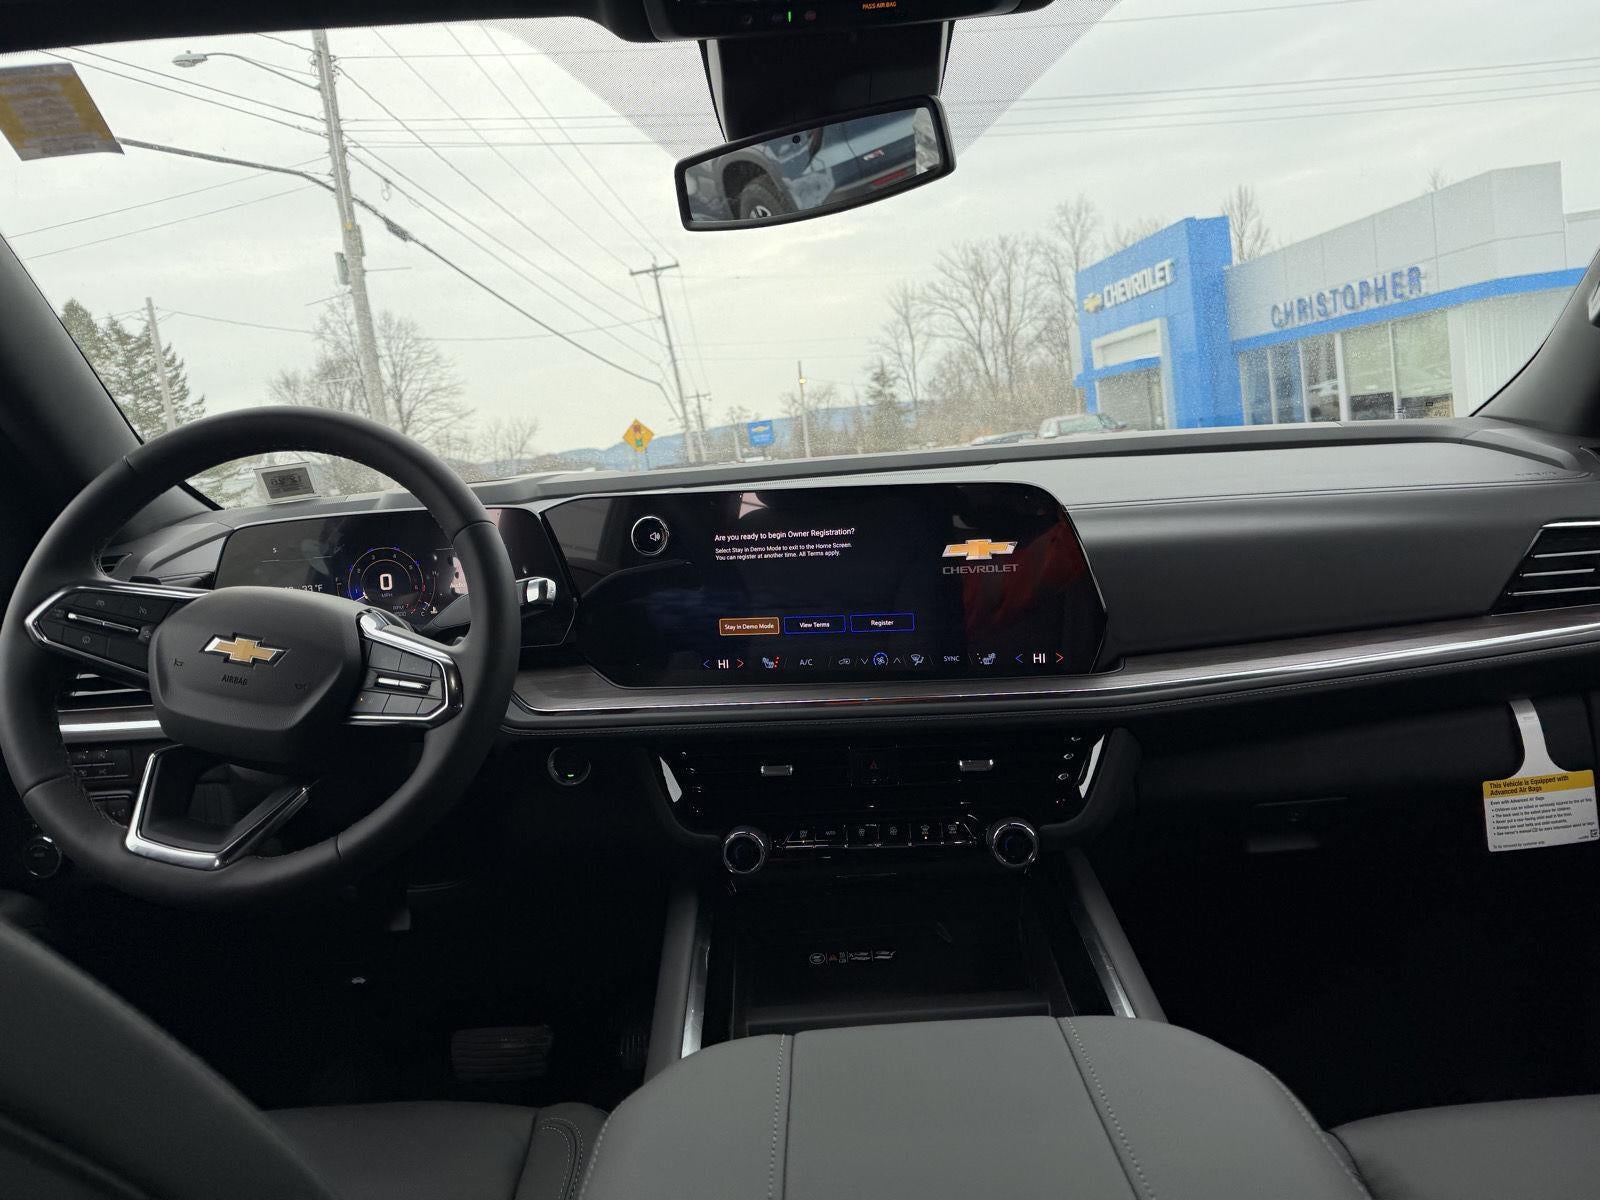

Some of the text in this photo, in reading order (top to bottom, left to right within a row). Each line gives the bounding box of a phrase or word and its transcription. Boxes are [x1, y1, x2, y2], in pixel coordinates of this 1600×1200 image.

[1104, 258, 1174, 308] CHEVROLET
[1271, 266, 1422, 328] CHRISTOPHER
[811, 528, 855, 537] Registration?
[942, 564, 1018, 574] CHEVROLET
[380, 574, 392, 590] 0
[1033, 653, 1045, 664] HI
[718, 660, 729, 669] HI
[1530, 776, 1556, 785] Equipped
[1490, 787, 1518, 796] Advanced
